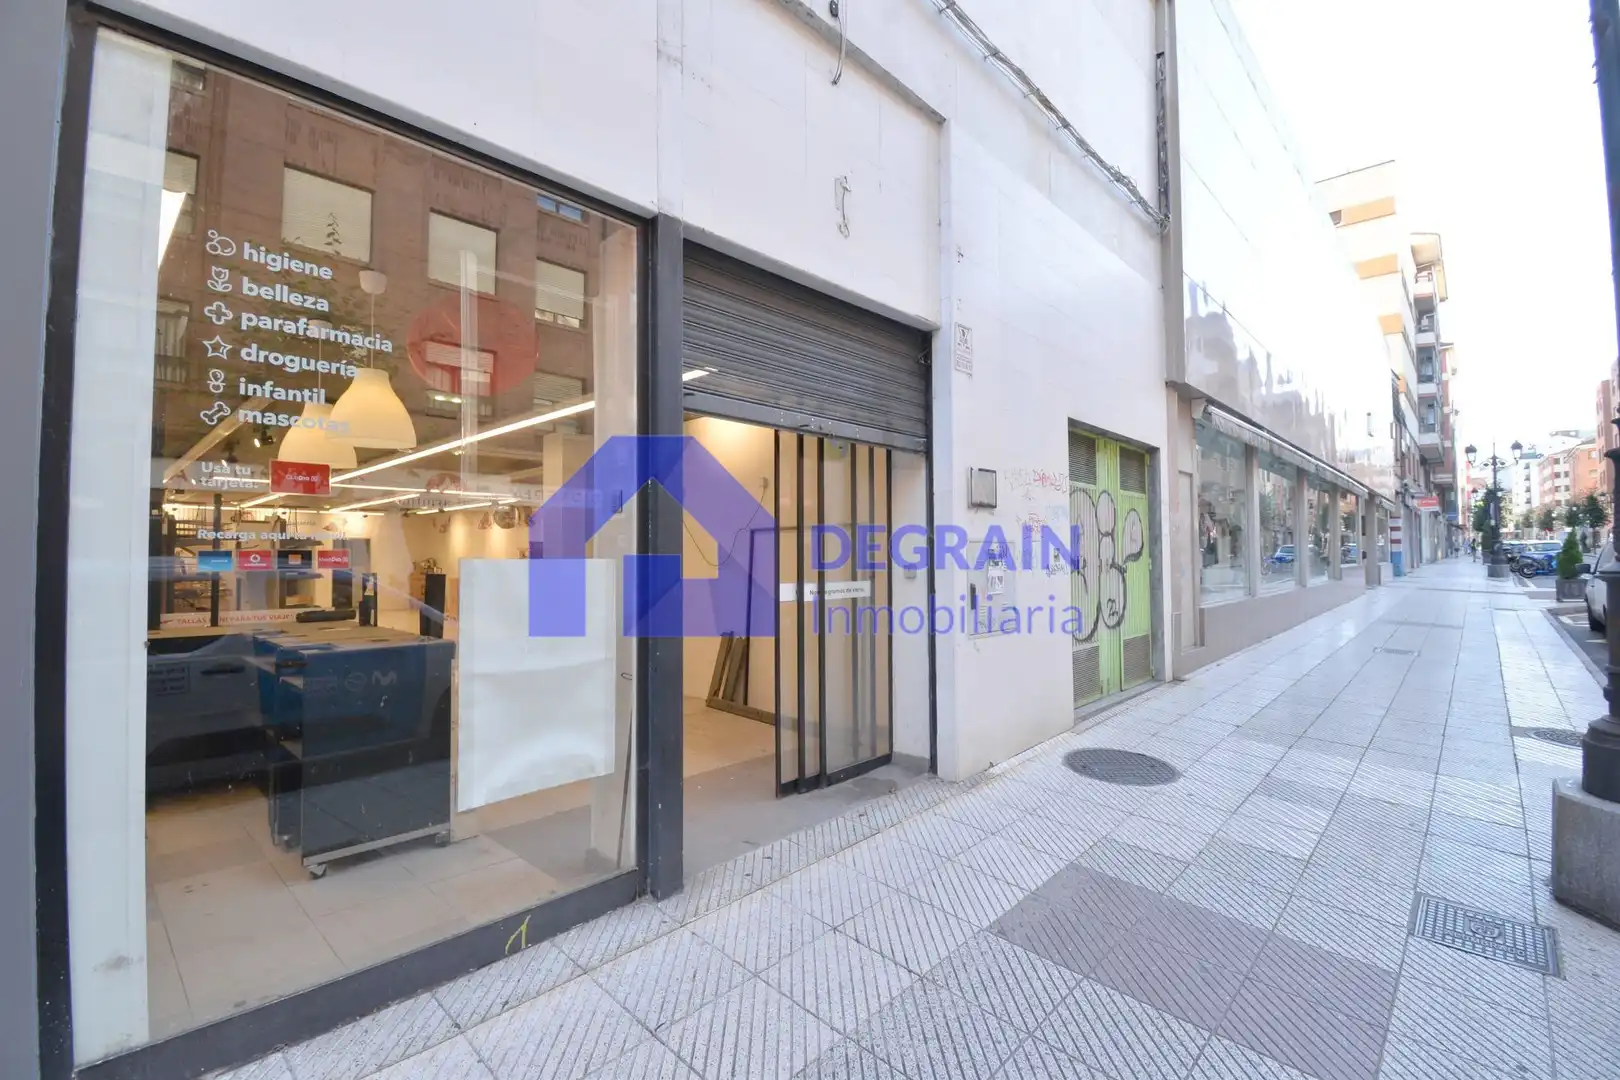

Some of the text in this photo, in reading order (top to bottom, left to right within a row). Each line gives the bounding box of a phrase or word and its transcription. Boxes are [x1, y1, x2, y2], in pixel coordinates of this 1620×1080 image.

[242, 242, 333, 280] higiene
[241, 276, 329, 312] belleza
[240, 311, 393, 353] parafarmacia
[240, 343, 360, 379] droguería
[239, 377, 326, 405] infantil
[238, 407, 353, 434] mascotas
[201, 461, 251, 475] Usa tu
[197, 528, 256, 542] Recarga
